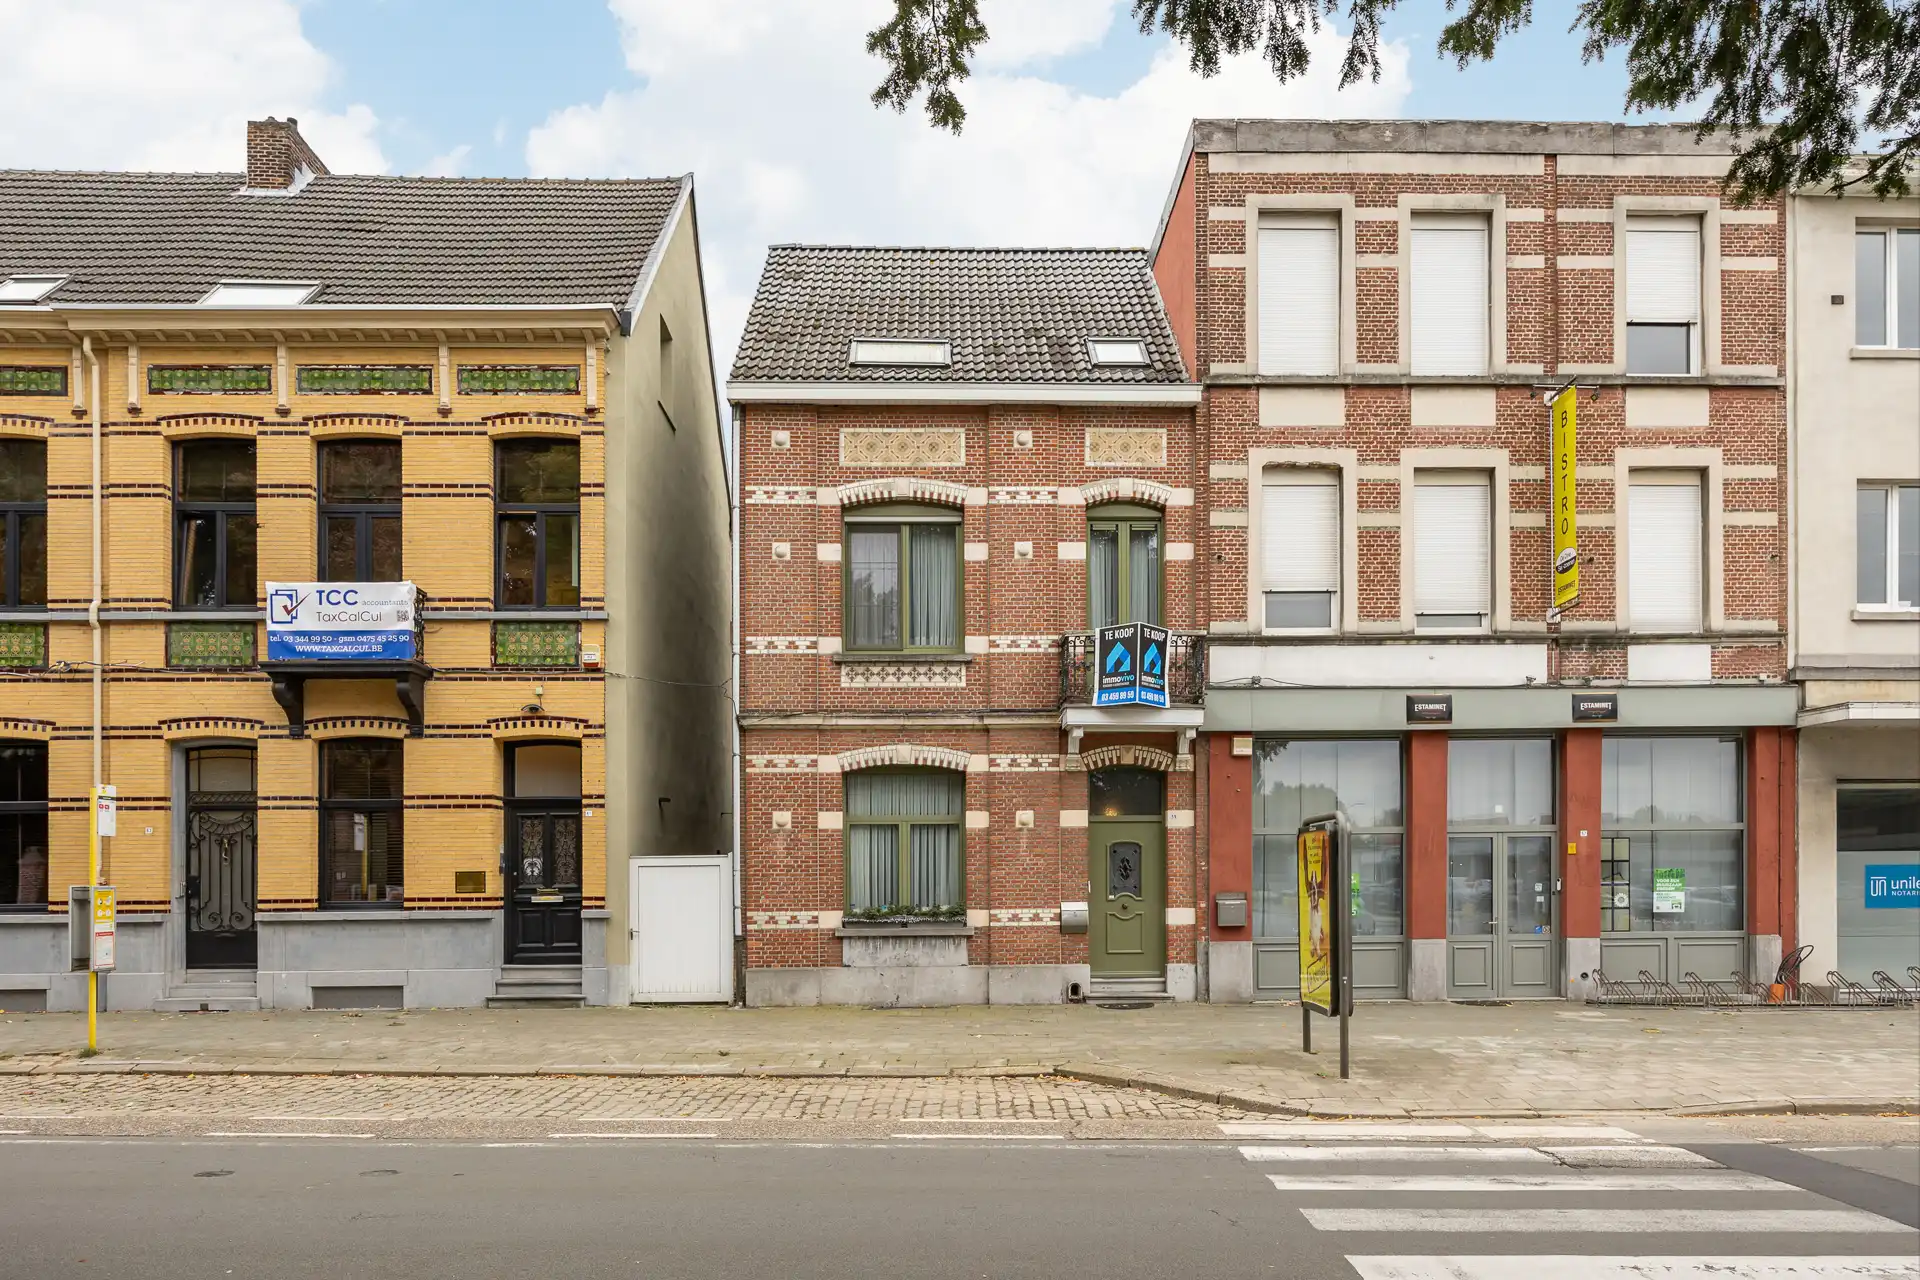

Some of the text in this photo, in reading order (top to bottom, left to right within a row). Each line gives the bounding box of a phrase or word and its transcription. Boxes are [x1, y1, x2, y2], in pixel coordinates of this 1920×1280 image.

[1561, 409, 1569, 535] BISTRO
[316, 589, 359, 606] TCC
[316, 611, 382, 622] TaxCalCul
[283, 635, 293, 643] 03
[357, 635, 375, 643] 0475
[1105, 628, 1134, 640] TE KOOP
[1144, 628, 1165, 641] TE KOOP
[1103, 673, 1134, 684] immovivo
[1142, 672, 1164, 685] immovivo
[1414, 703, 1447, 712] ESTAMINET
[1580, 702, 1612, 711] ESTAMINET
